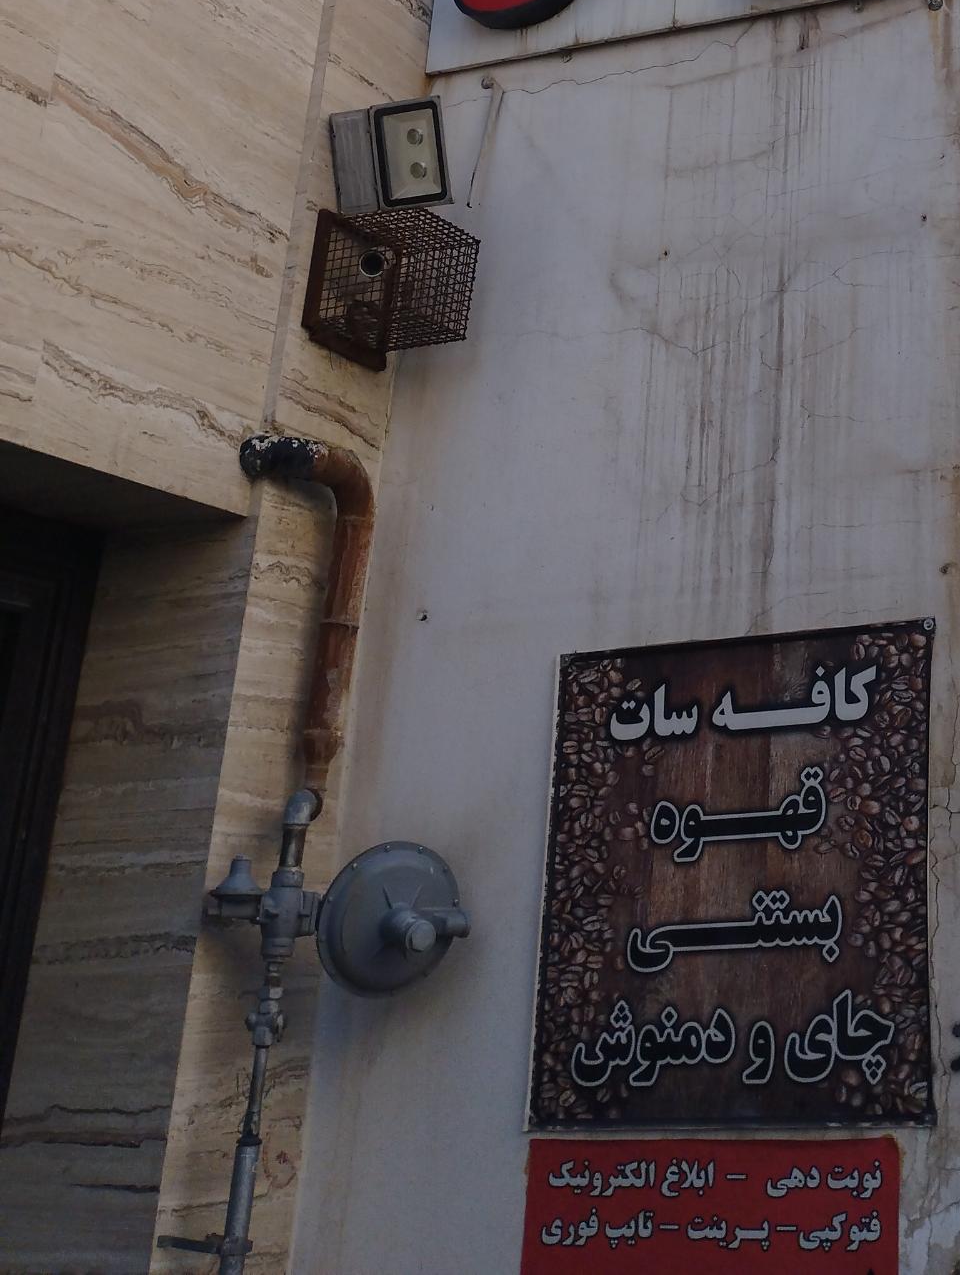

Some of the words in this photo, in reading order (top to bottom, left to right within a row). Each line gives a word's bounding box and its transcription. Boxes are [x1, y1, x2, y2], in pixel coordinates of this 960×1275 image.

[609, 683, 699, 741] سات
[711, 664, 877, 731] کافه
[650, 765, 829, 863] قهوه
[628, 890, 843, 973] بستنی
[571, 1000, 736, 1087] دمنوش
[742, 1019, 775, 1085] و
[784, 989, 895, 1085] چای
[548, 1159, 656, 1197] الکترونیک
[660, 1158, 715, 1197] ابلاغ
[766, 1165, 821, 1198] دهی
[826, 1160, 882, 1199] نوبت
[541, 1208, 599, 1246] فوری
[605, 1209, 654, 1249] تایپ
[687, 1214, 770, 1249] پرینت
